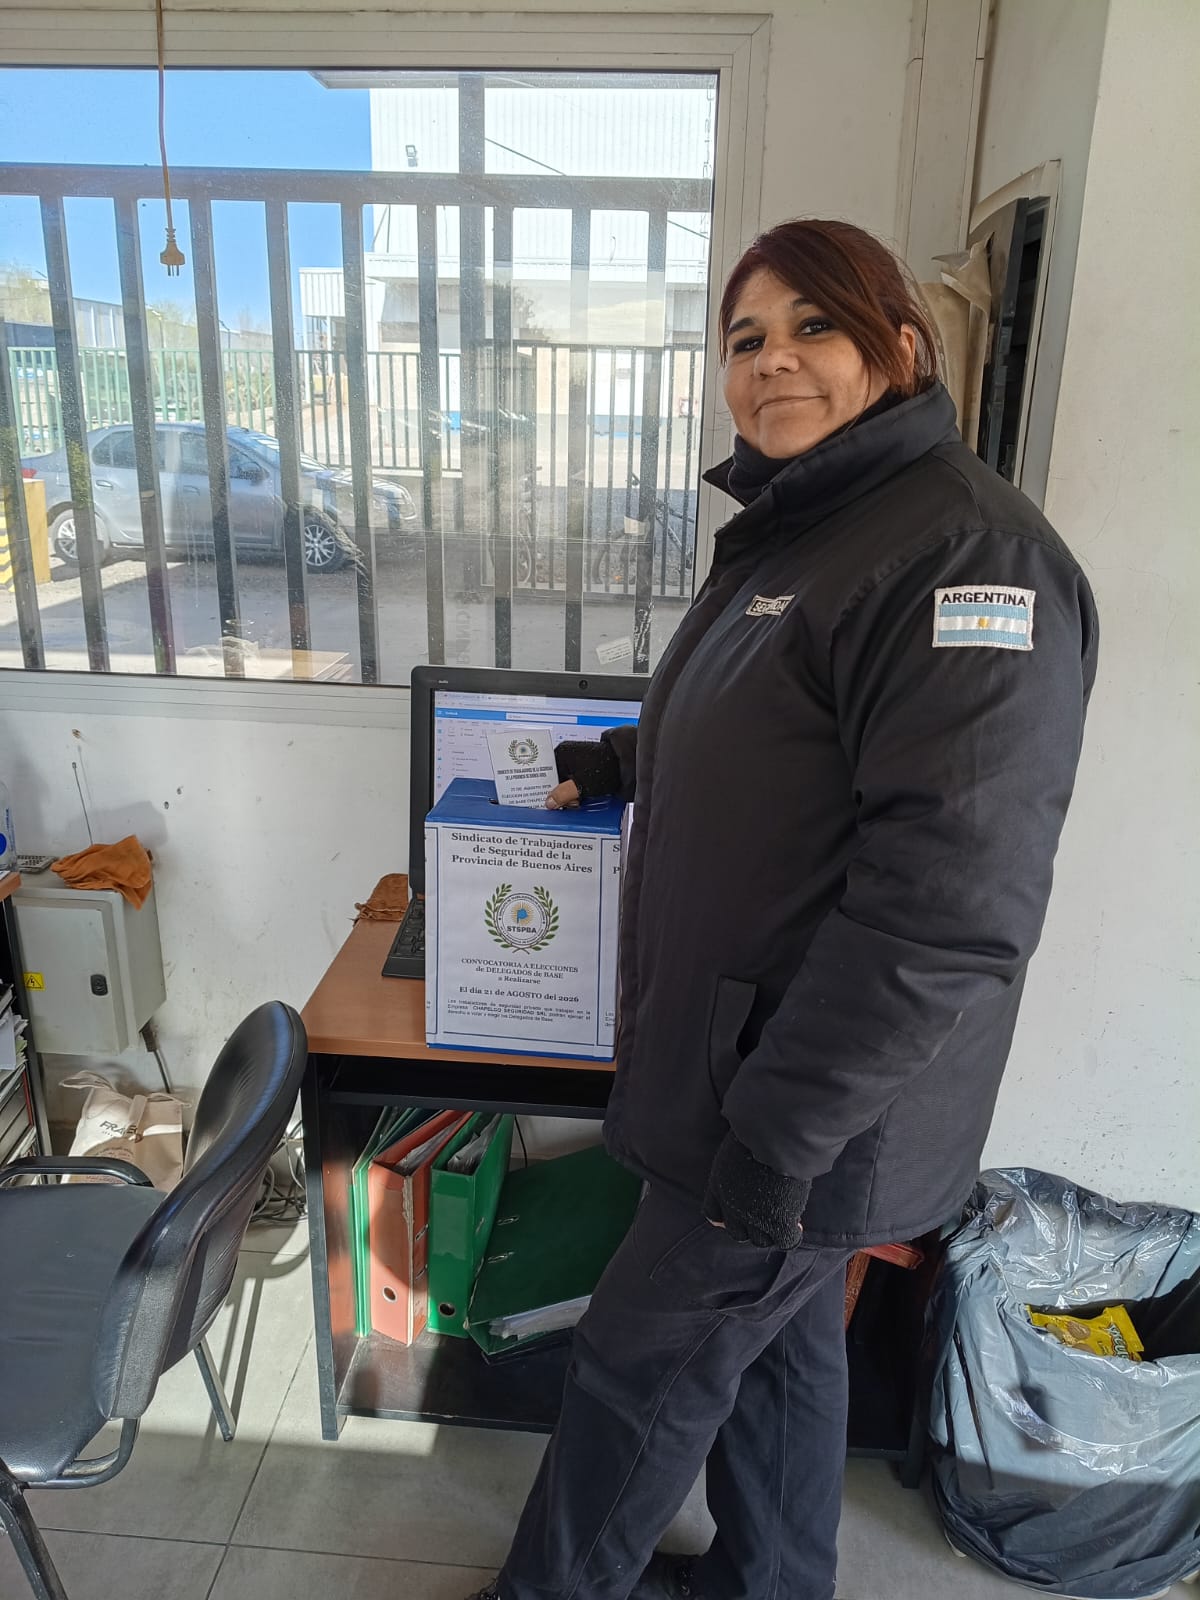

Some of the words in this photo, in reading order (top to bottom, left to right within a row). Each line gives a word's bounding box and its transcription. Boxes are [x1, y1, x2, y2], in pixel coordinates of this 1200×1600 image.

[941, 592, 1026, 607] ARGENTINA
[451, 832, 503, 844] Sindicato
[505, 836, 518, 845] de
[520, 837, 593, 851] Trabajadores
[473, 845, 486, 854] de
[488, 846, 543, 858] Seguridad
[546, 851, 559, 859] de
[562, 851, 571, 860] la
[451, 855, 503, 866] Provincia
[505, 859, 519, 867] de
[522, 860, 561, 871] Buenos
[564, 863, 593, 873] Aires
[461, 958, 522, 968] CONVOCATORIA
[530, 963, 579, 973] ELECCIONES
[486, 967, 532, 976] DELEGADOS
[544, 971, 564, 979] BASE
[504, 976, 541, 984] Realizarse
[506, 990, 543, 999] AGOSTO
[544, 993, 557, 1001] del
